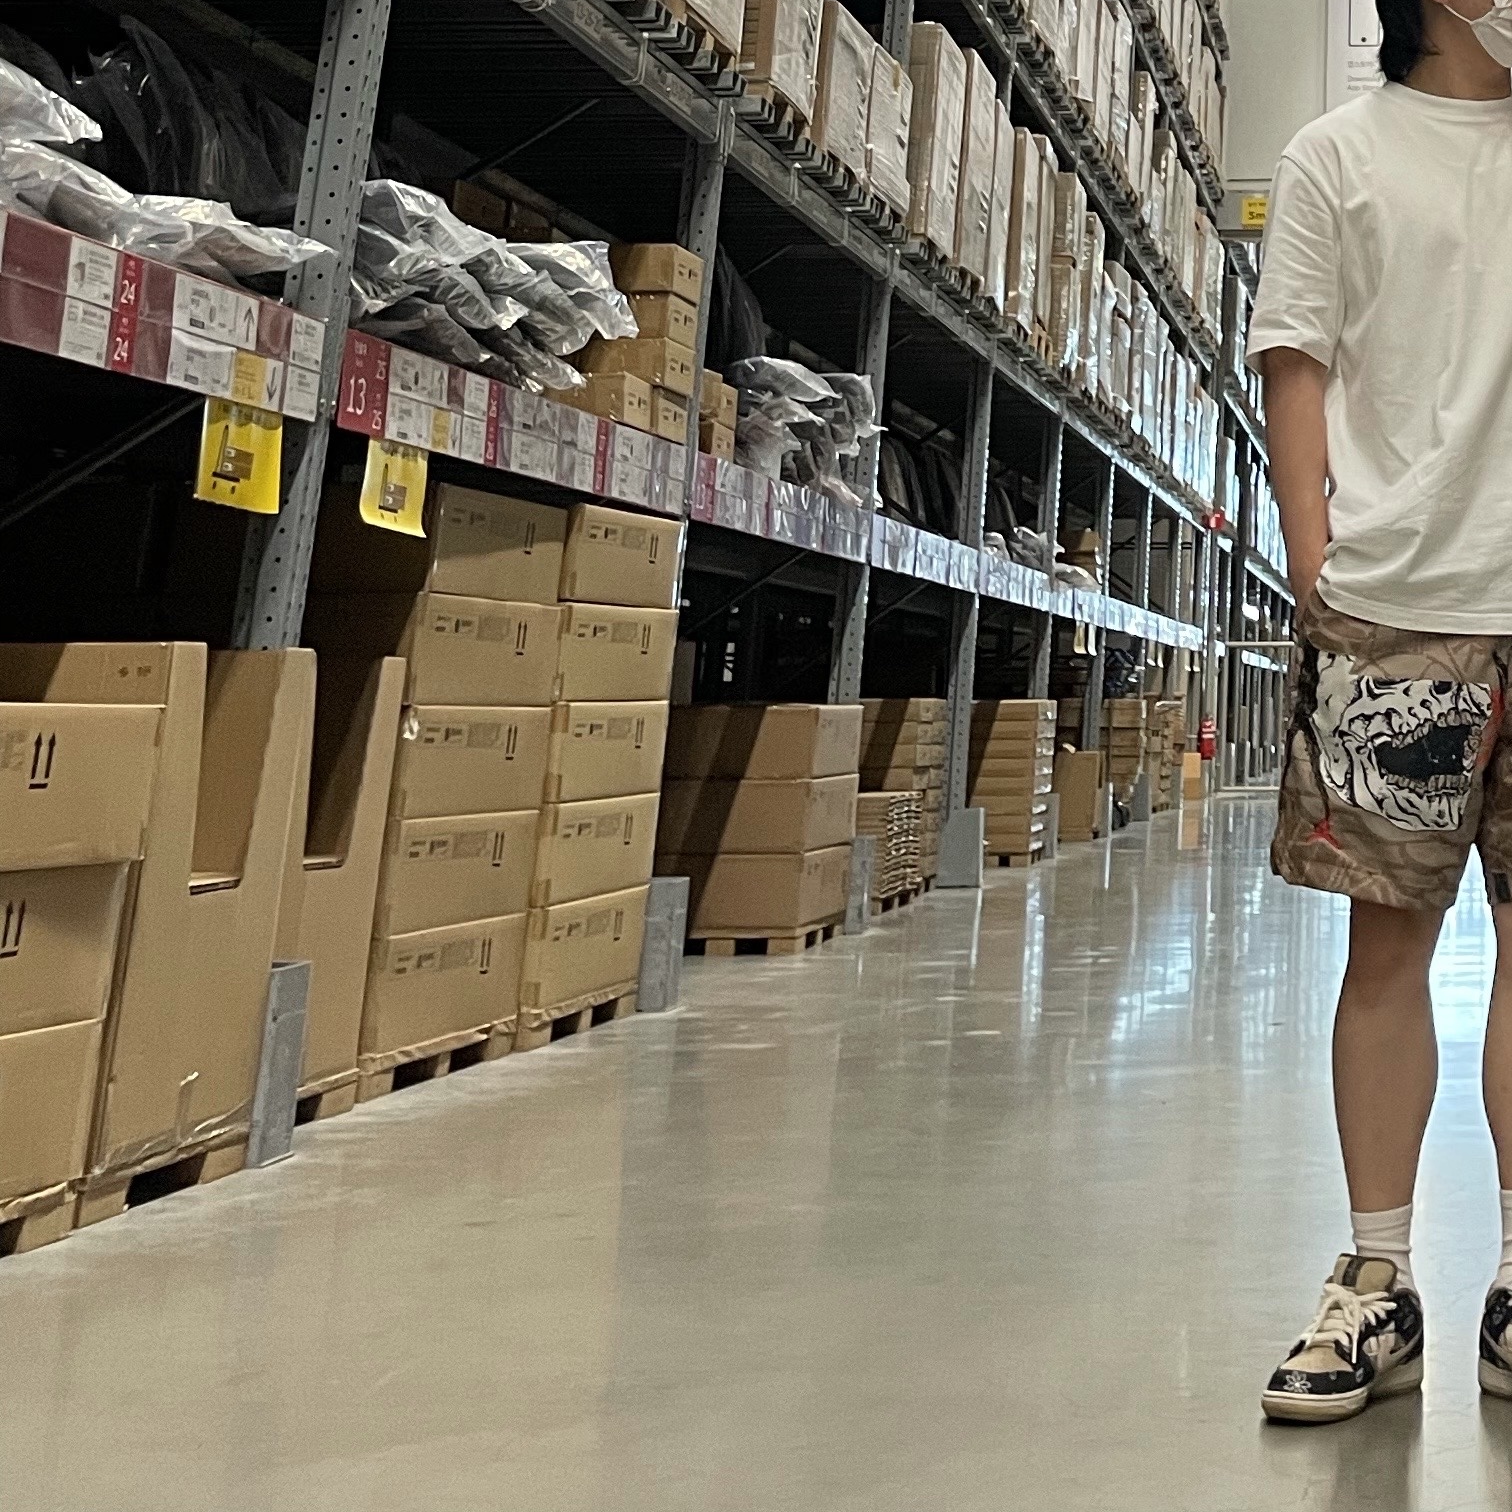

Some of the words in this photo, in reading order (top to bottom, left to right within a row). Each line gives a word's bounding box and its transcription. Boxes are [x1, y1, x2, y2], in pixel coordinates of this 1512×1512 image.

[120, 279, 136, 306] 24
[114, 337, 129, 363] 24
[346, 374, 367, 416] 13
